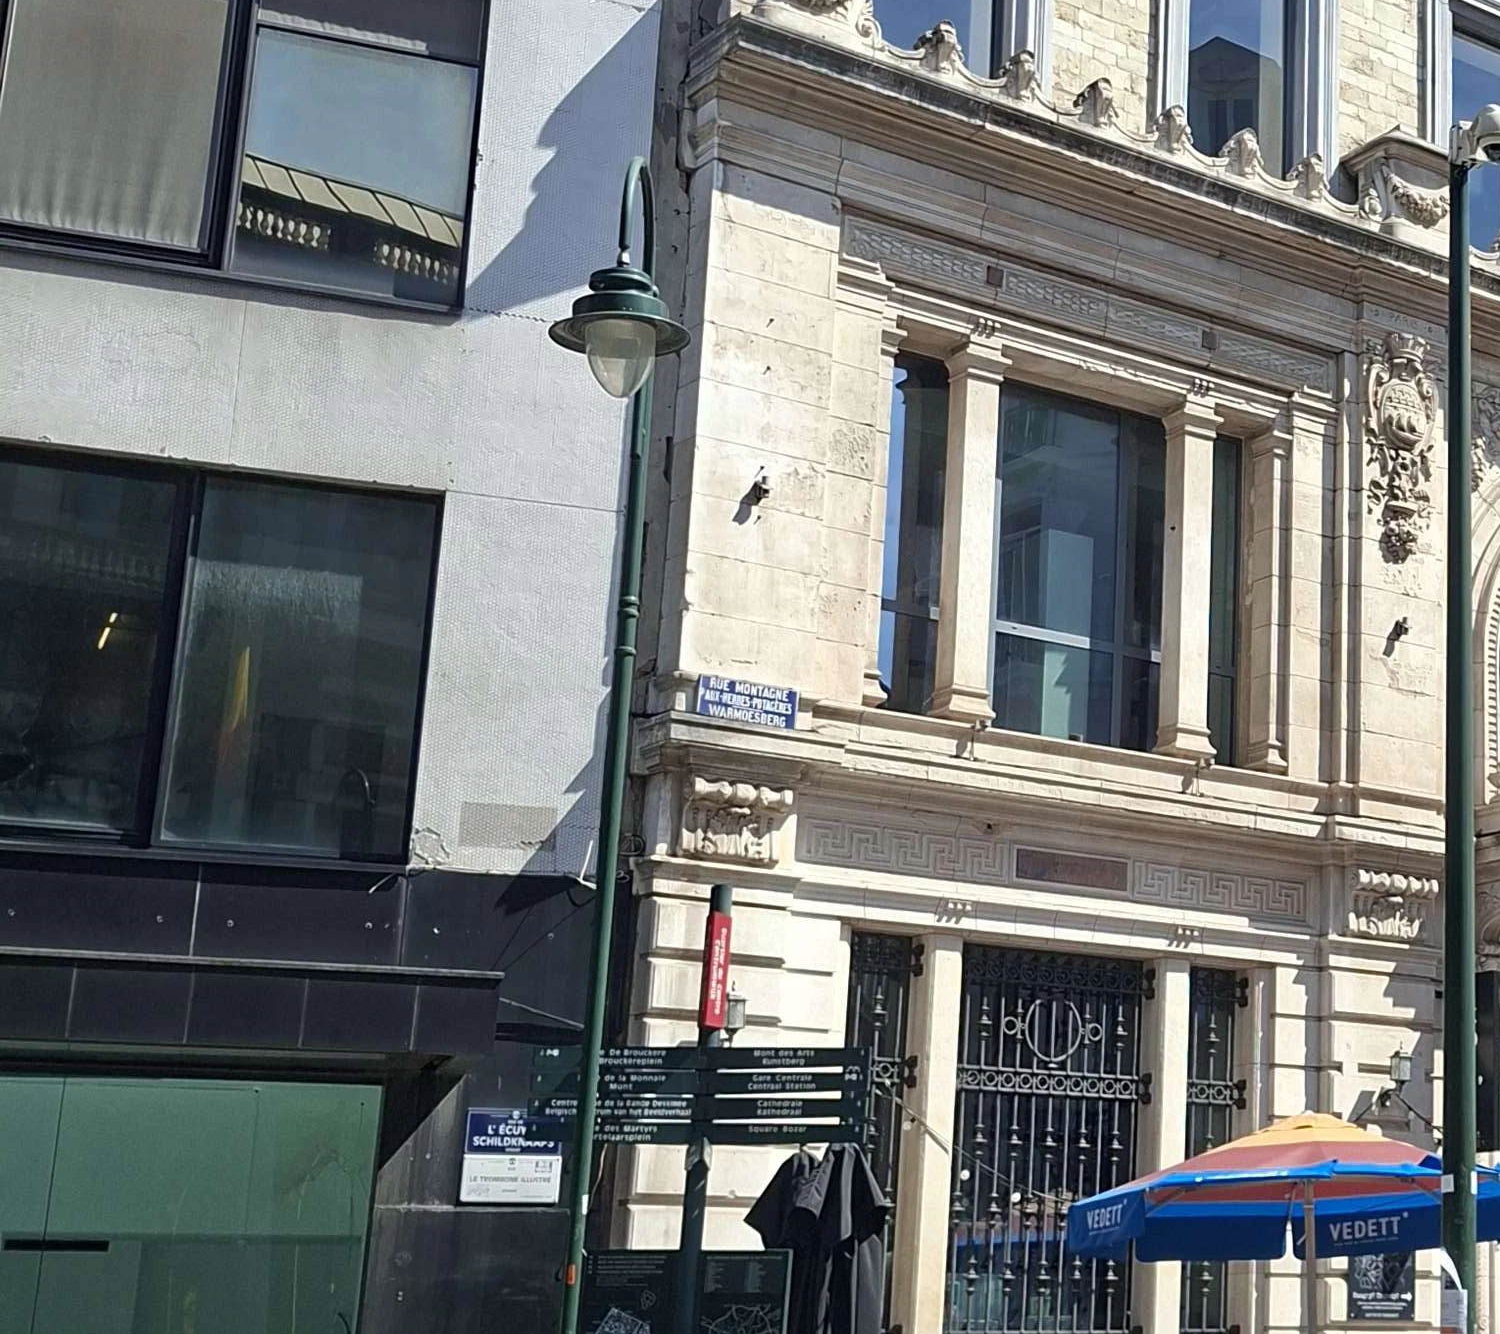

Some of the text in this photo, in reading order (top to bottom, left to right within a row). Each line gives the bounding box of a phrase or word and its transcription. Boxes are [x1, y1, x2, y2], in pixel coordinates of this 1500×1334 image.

[709, 677, 789, 702] RUE MONTAGNE
[708, 703, 787, 728] WARMOESBERG
[551, 1099, 578, 1107] Centre
[594, 1133, 651, 1142] rtelaarsplein
[1087, 1204, 1123, 1230] VEDETT
[1329, 1217, 1401, 1242] VEDETT
